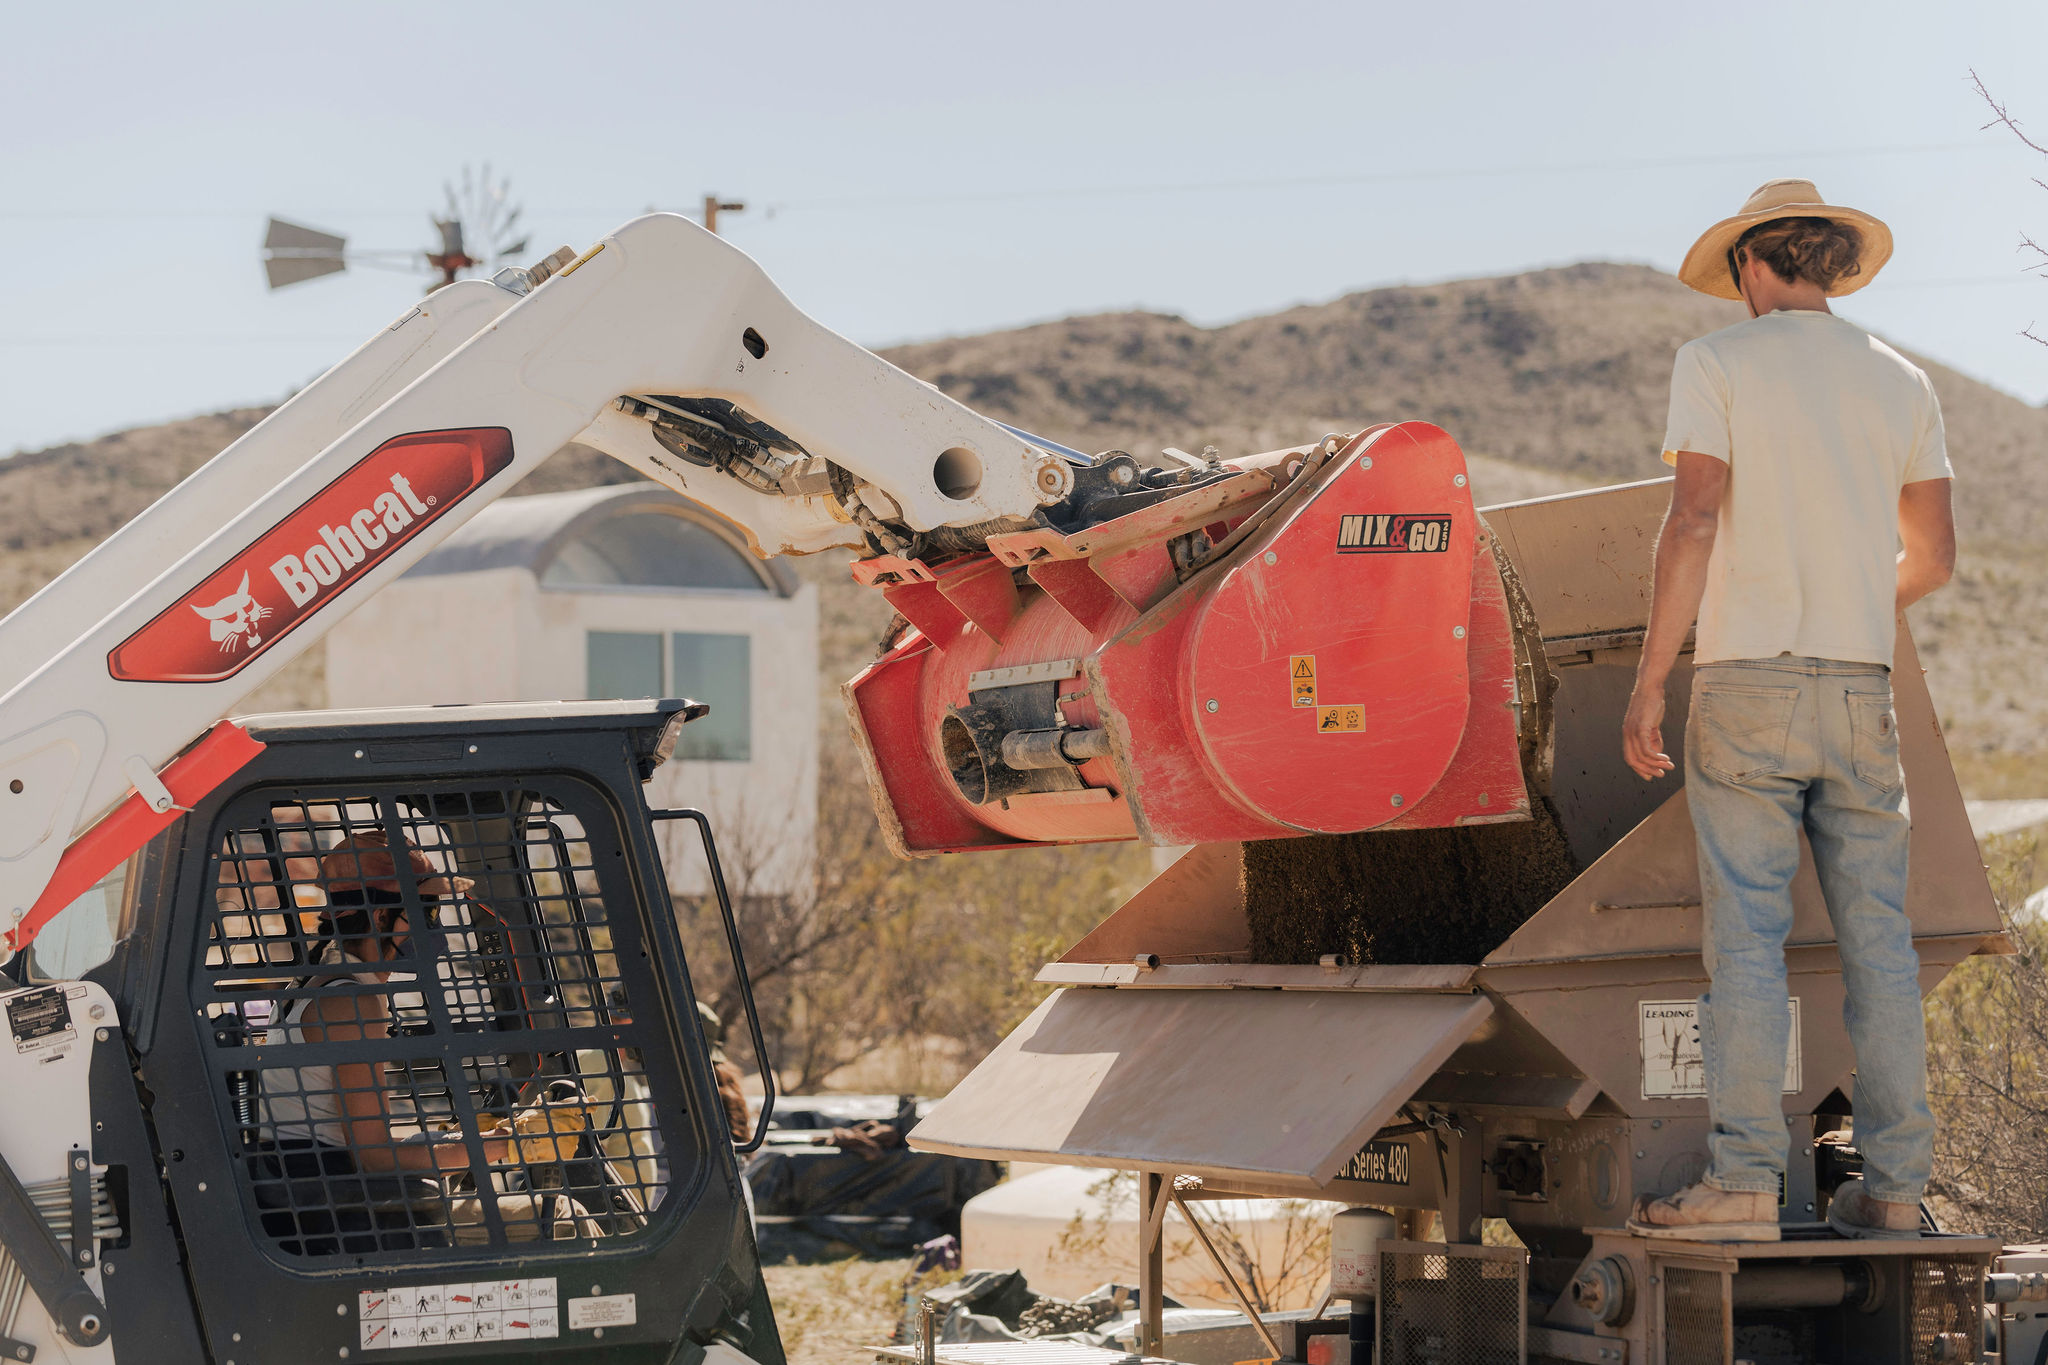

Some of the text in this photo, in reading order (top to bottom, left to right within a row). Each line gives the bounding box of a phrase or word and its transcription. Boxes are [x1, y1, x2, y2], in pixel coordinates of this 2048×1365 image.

[269, 471, 429, 608] Bobcat
[1645, 1010, 1694, 1018] LEADING
[1353, 1143, 1385, 1181] Series
[1388, 1145, 1409, 1183] 480
